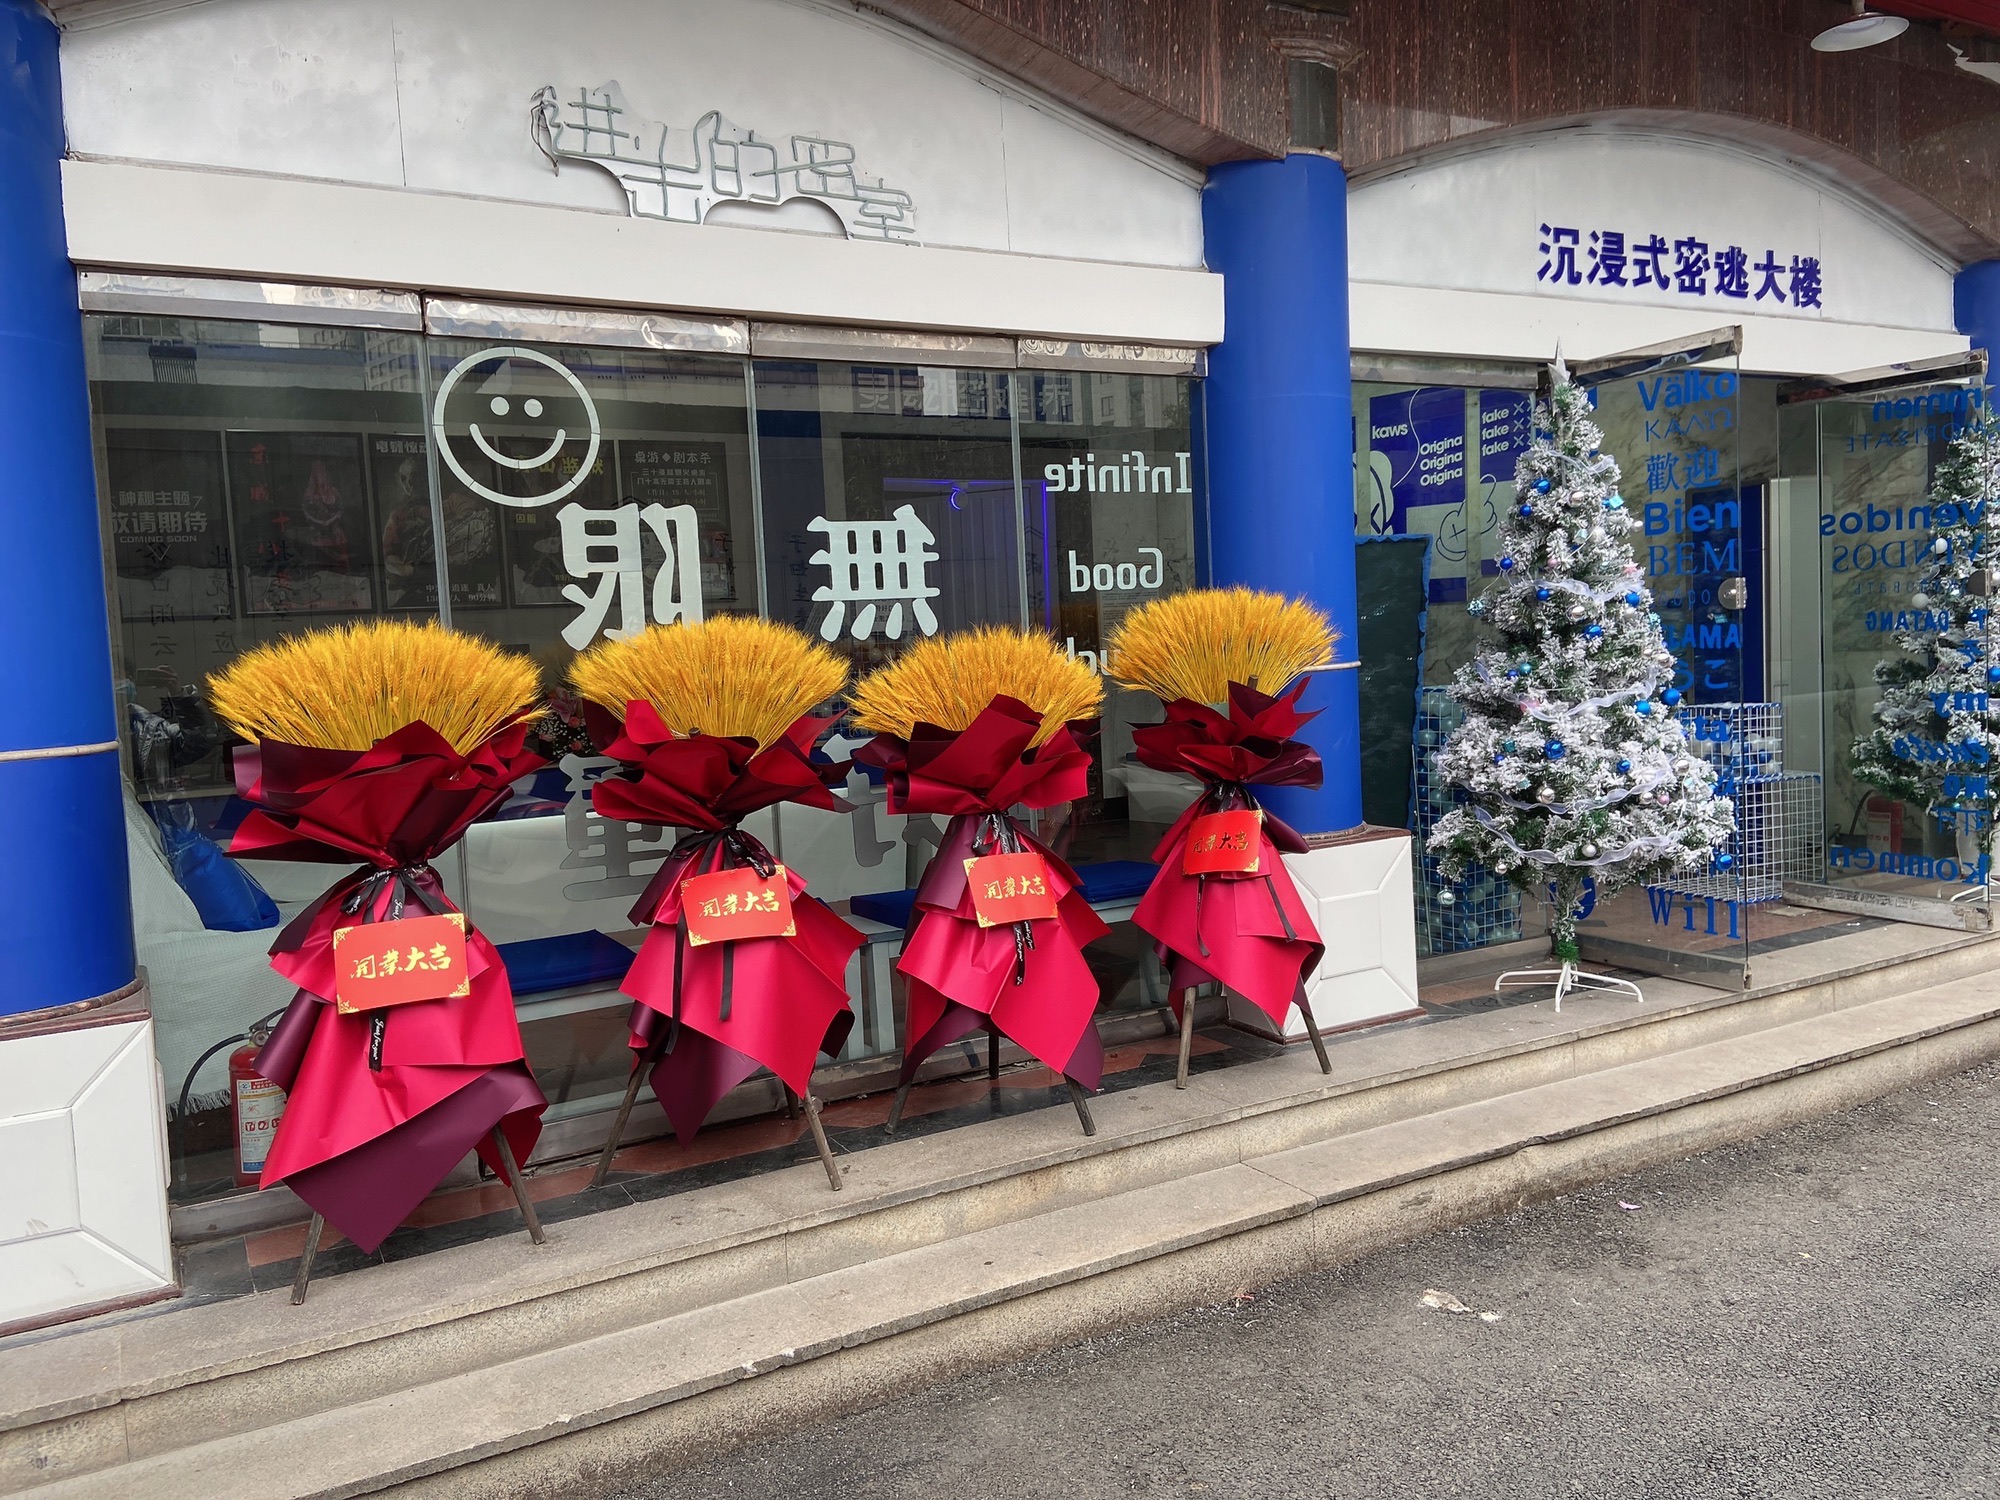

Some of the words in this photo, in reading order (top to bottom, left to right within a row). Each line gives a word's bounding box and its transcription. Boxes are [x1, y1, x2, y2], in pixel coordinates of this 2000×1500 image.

[1536, 222, 1824, 310] 沉浸式密逃大楼
[1637, 369, 1737, 412] Välko
[1481, 406, 1509, 424] fake
[1372, 424, 1408, 440] kaws
[1481, 423, 1509, 440] fake
[1419, 435, 1463, 456] Origina
[1481, 439, 1509, 457] fake
[634, 451, 660, 464] 桌游
[673, 451, 711, 465] 剧本杀
[1419, 451, 1463, 472] Origina
[1419, 466, 1463, 488] Origina
[1645, 446, 1721, 494] 歡迎
[119, 490, 190, 506] 神秘主题
[1644, 498, 1738, 537] Bien
[119, 535, 164, 544] COMING
[166, 535, 197, 544] SOON
[1648, 538, 1738, 577] BEM
[1646, 885, 1742, 940] Will
